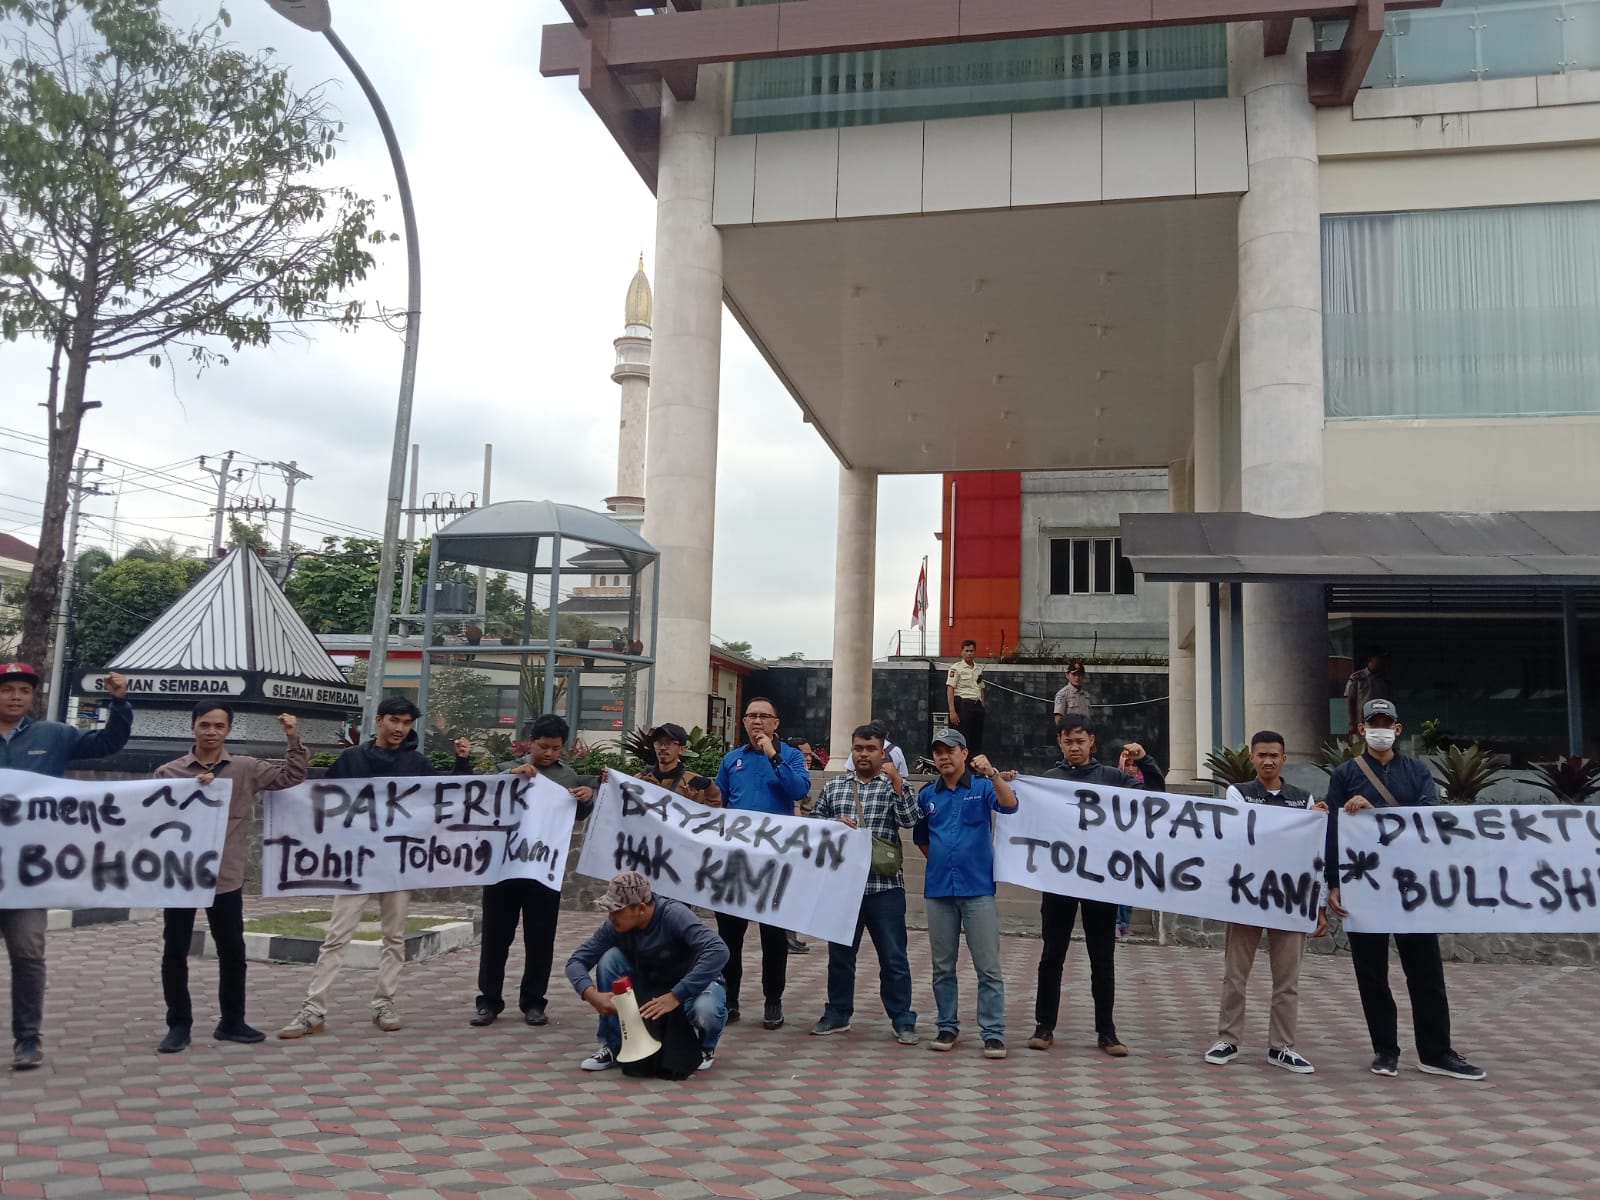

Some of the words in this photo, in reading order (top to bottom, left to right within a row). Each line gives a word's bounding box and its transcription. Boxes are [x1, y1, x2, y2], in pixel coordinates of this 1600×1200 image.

[159, 679, 229, 693] SEMBADA
[272, 684, 314, 700] SLEMAN
[316, 689, 359, 705] SEMBADA
[310, 781, 420, 834] PAK
[619, 782, 848, 871] BAYARKAN
[1072, 789, 1256, 847] BUPATI
[383, 835, 494, 876] Tolong
[614, 831, 681, 885] HAK
[1009, 836, 1205, 893] TOLONG
[1392, 858, 1600, 913] BULLSH
